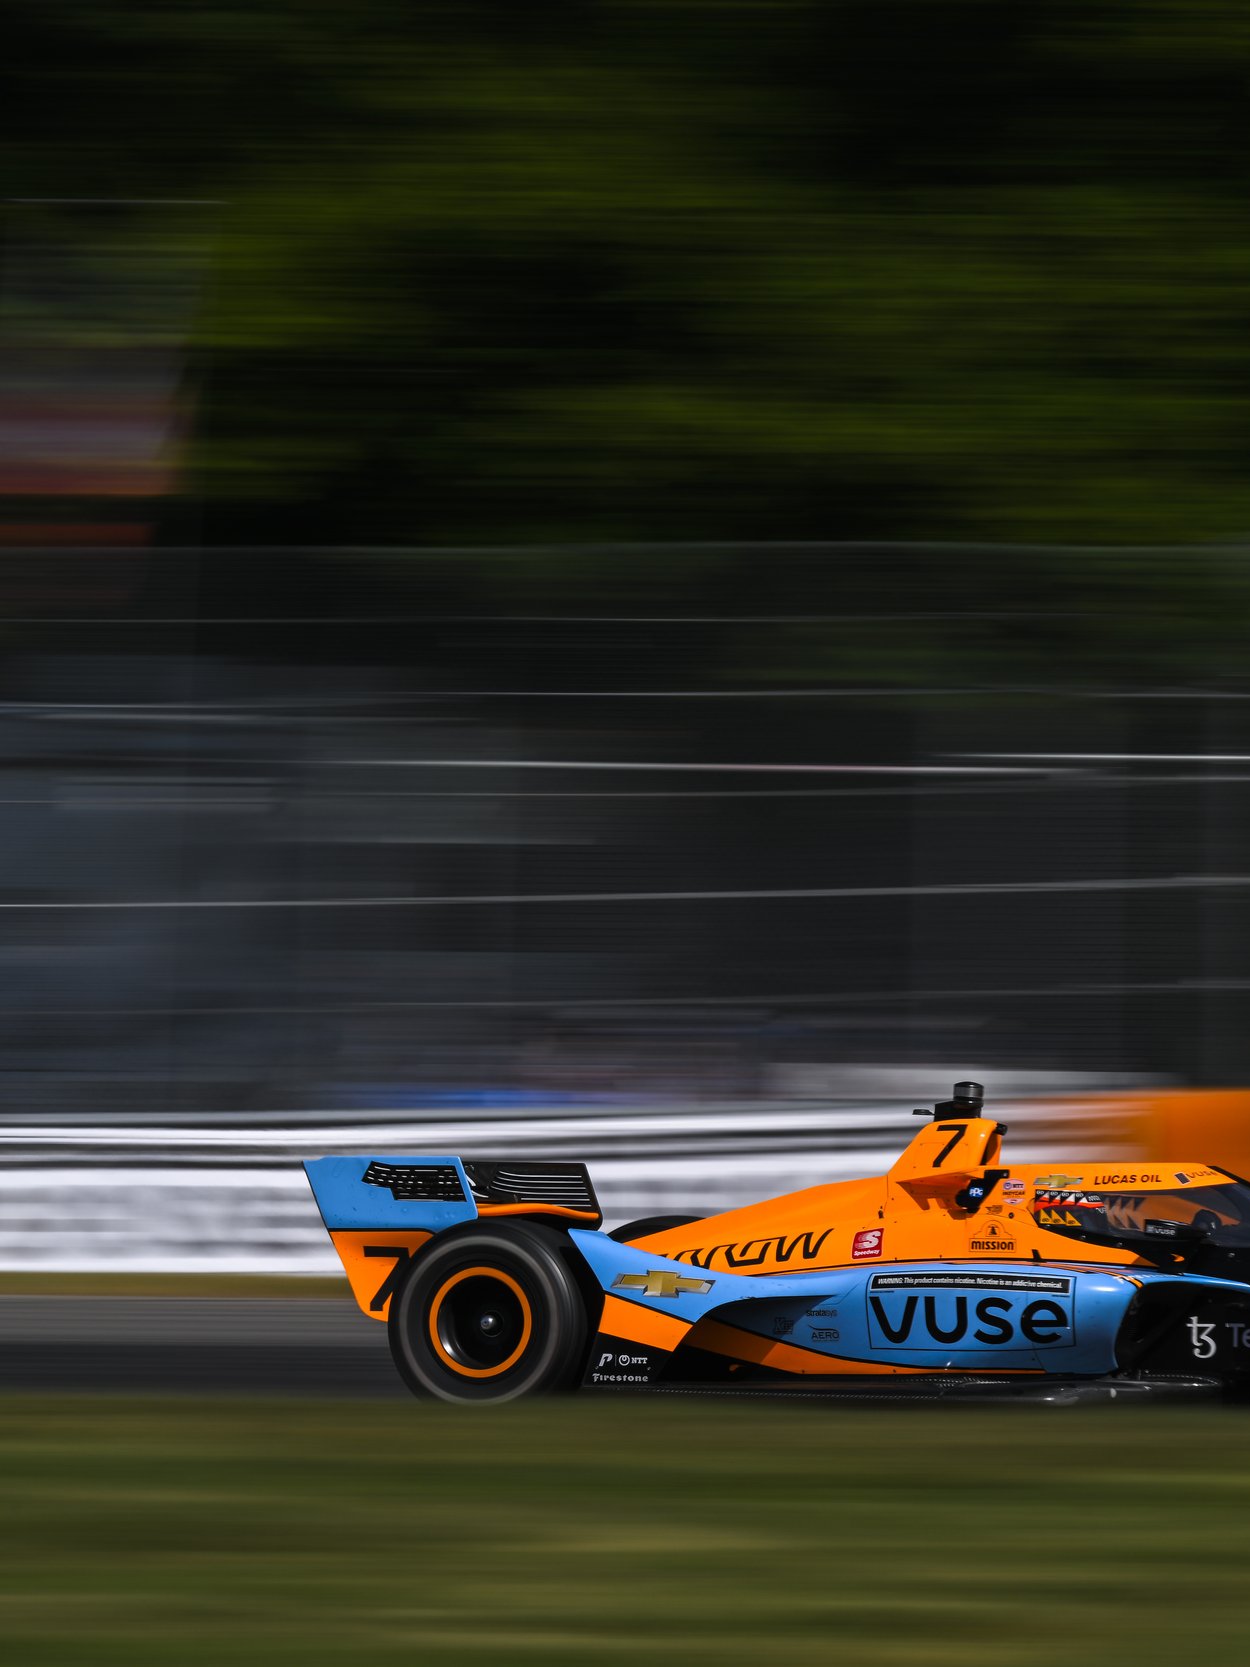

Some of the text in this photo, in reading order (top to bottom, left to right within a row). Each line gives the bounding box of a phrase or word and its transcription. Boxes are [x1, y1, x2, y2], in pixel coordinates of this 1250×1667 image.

[934, 1124, 968, 1167] 7
[1094, 1174, 1162, 1185] LUCAS OIL
[363, 1245, 409, 1311] 7
[811, 1331, 839, 1340] AERO
[592, 1373, 648, 1382] Firestone
